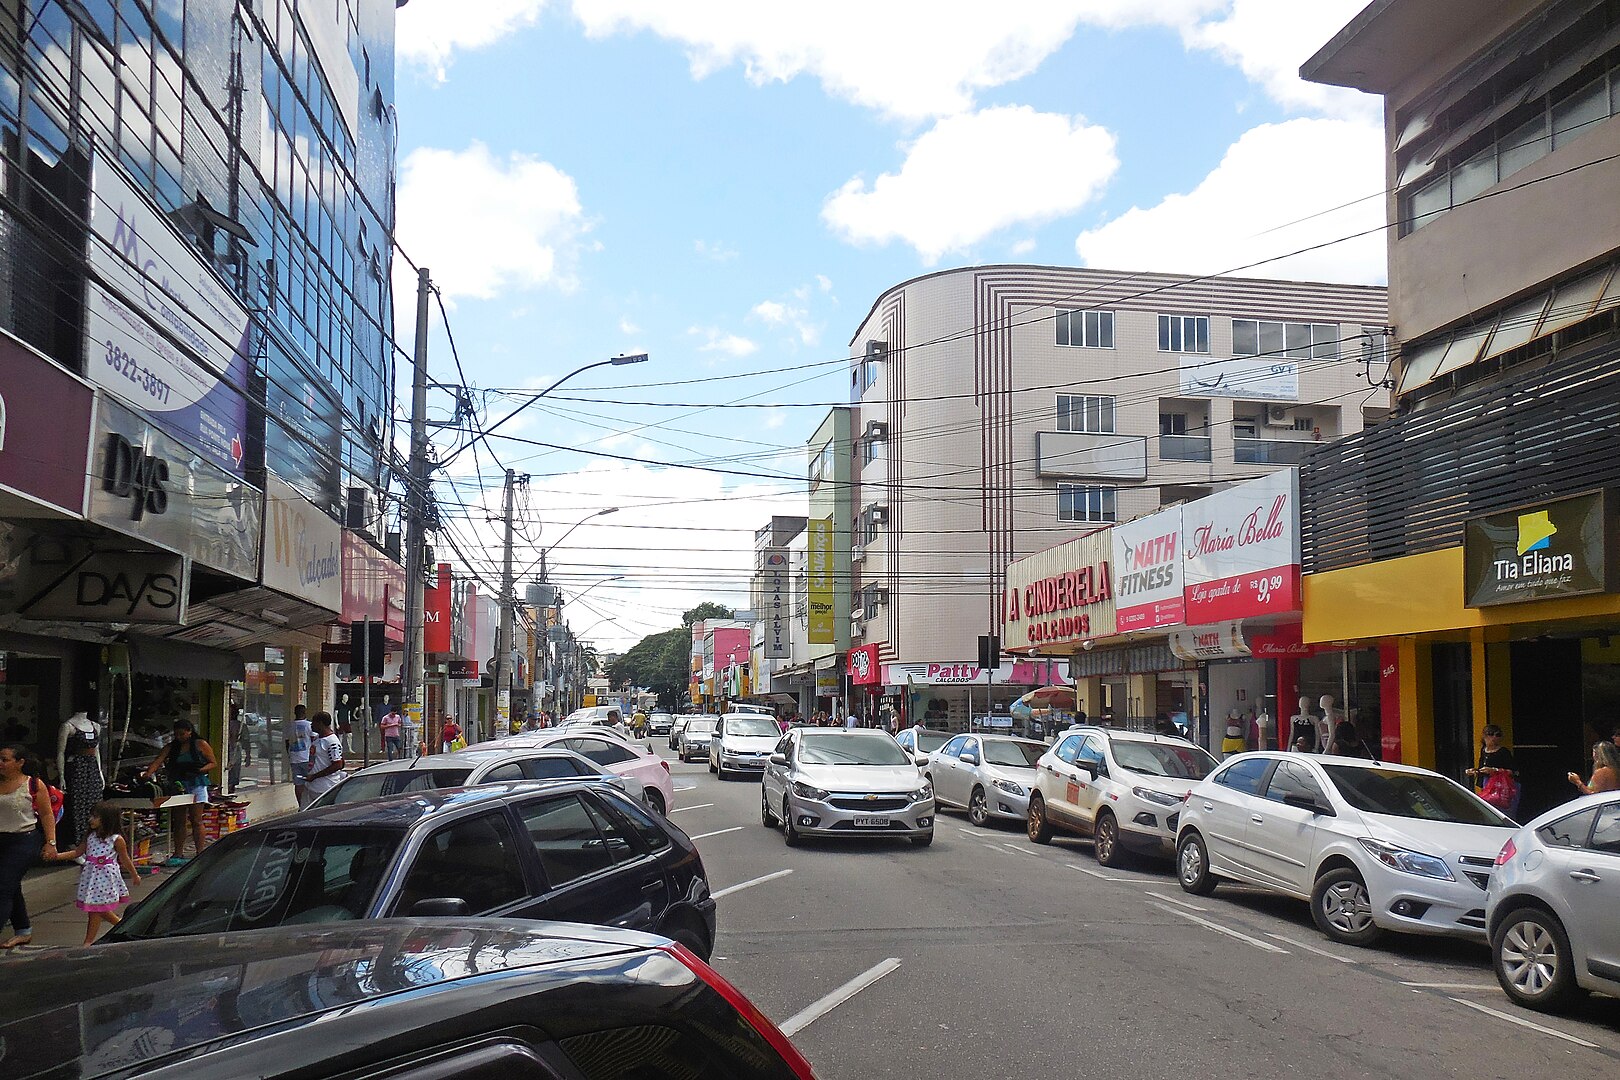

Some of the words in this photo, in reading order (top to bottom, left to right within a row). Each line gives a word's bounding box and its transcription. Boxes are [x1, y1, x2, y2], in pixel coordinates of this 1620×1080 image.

[105, 340, 170, 405] 3822-3897
[103, 432, 169, 521] DAYS
[1188, 521, 1235, 559] Maria
[1238, 493, 1286, 546] Bella
[1133, 531, 1177, 571] NATH
[1493, 560, 1518, 580] Tia
[1523, 551, 1573, 576] Eliana
[76, 571, 177, 615] DAYS
[773, 571, 781, 608] LOJAS
[1009, 587, 1020, 622] A
[1023, 561, 1112, 618] CINDERELA
[1119, 563, 1174, 596] FITNESS
[1495, 583, 1514, 592] Amor
[1527, 577, 1543, 588] tudo
[773, 614, 783, 651] ALVIM
[1194, 646, 1224, 656] FITNESS
[1198, 632, 1219, 647] NATH
[1258, 643, 1286, 654] Maria
[927, 663, 982, 680] Patty
